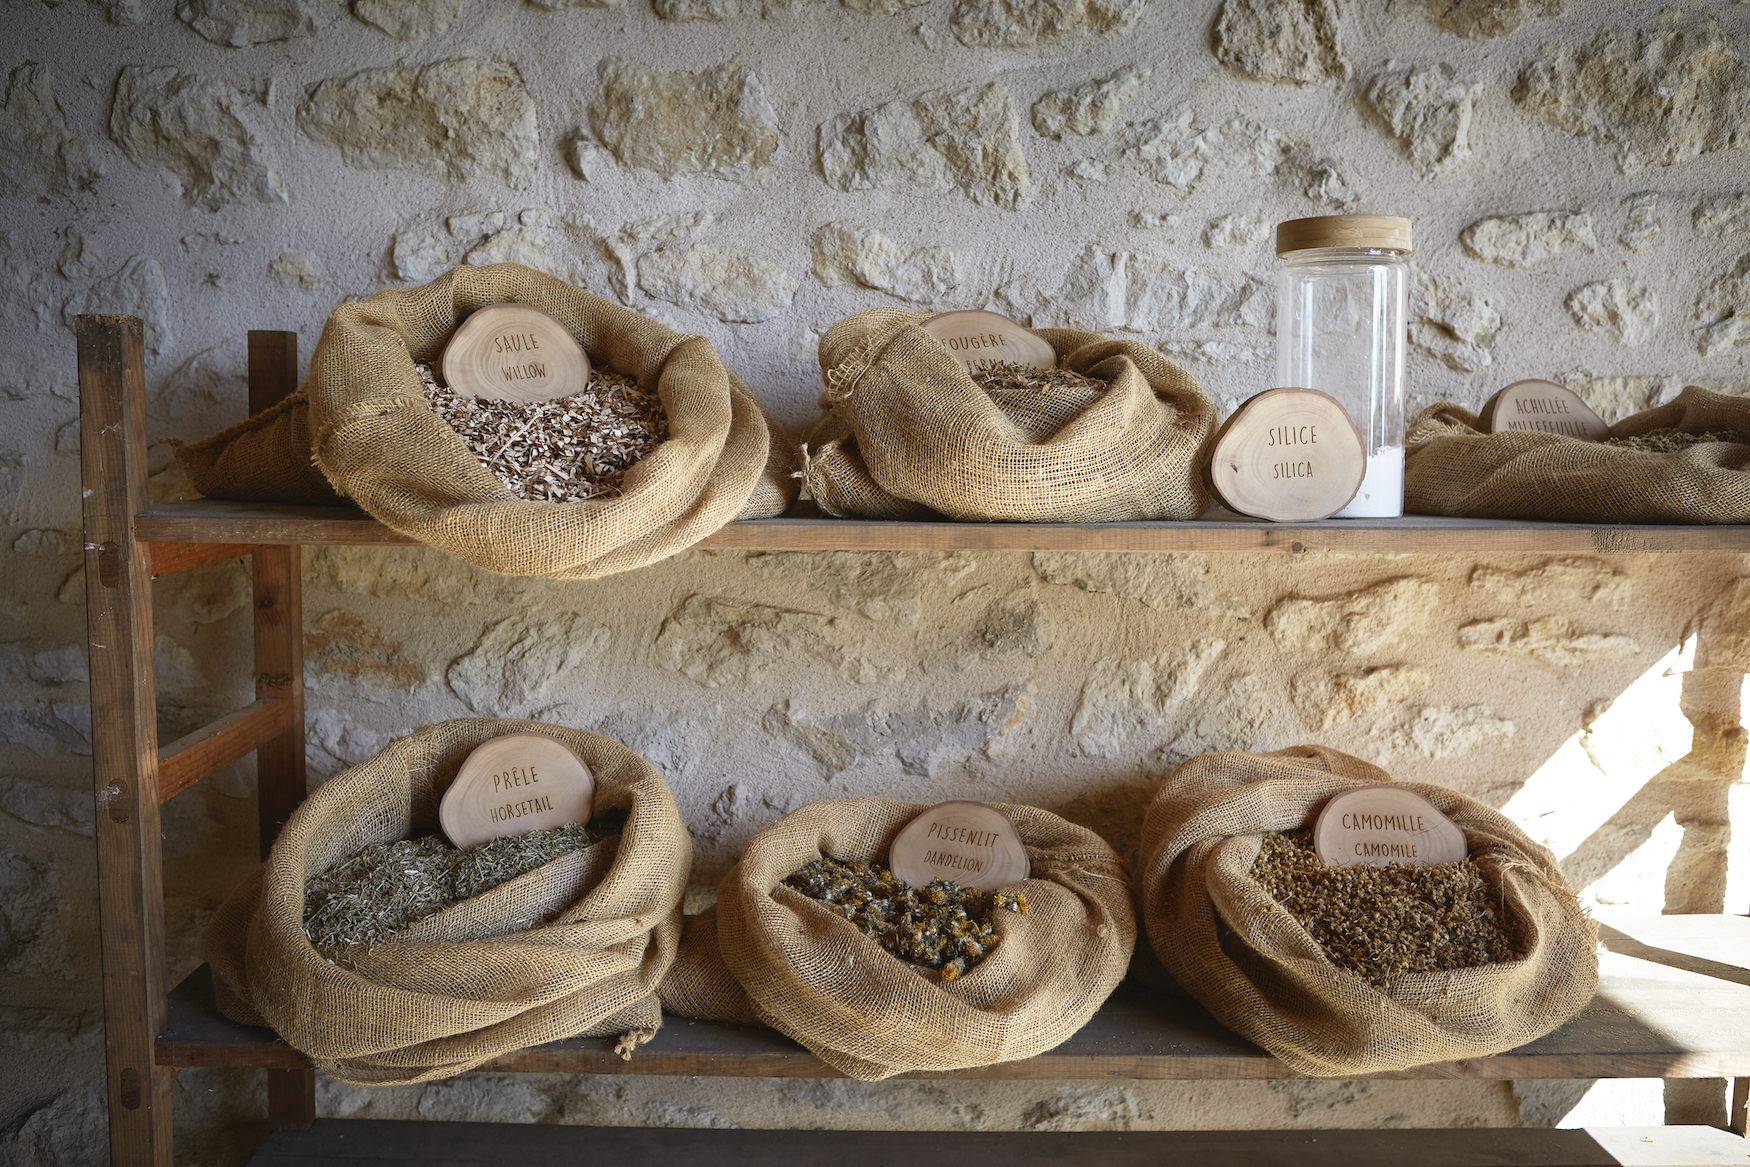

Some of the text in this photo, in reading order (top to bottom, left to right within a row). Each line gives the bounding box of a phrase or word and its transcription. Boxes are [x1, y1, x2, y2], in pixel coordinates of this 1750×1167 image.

[494, 333, 539, 353] SAULE
[941, 333, 1007, 351] FOUGÈRE
[501, 363, 547, 382] WILLOW
[1515, 396, 1570, 415] ACHILLÉE
[1268, 425, 1318, 446] SILICE
[1273, 461, 1314, 479] SILICA
[493, 766, 539, 793] PRÊLE
[490, 796, 554, 824] HORSETAIL
[1342, 813, 1424, 832] CAMOMILLE
[927, 822, 1000, 848] PISSENLIT
[1354, 842, 1418, 858] CAMOMILE
[924, 850, 984, 873] DANDELION
